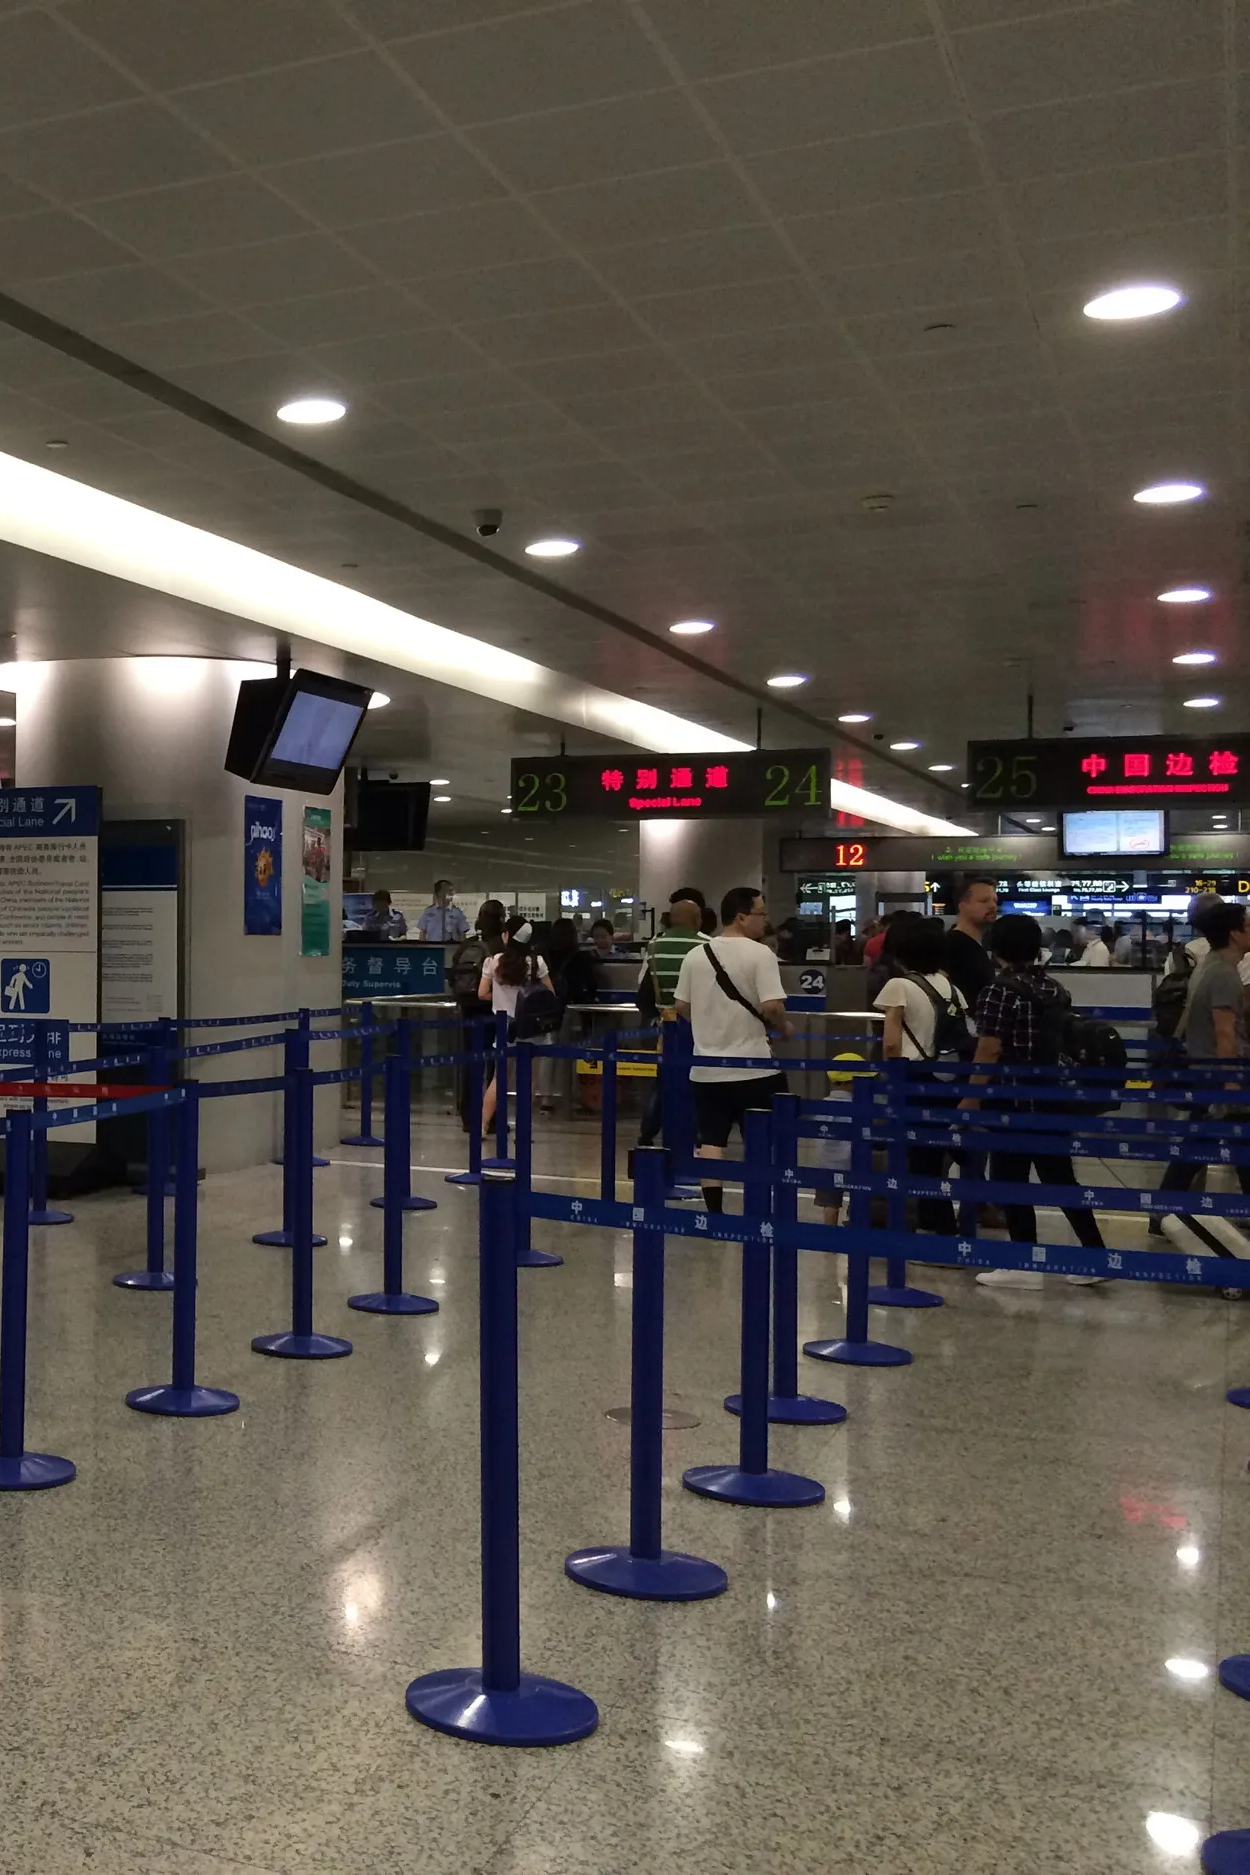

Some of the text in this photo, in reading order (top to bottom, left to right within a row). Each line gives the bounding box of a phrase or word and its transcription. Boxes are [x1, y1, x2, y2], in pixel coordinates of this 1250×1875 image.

[976, 755, 1038, 799] 25
[1081, 750, 1238, 778] 中国边检
[601, 765, 729, 791] 特别通道
[764, 764, 822, 806] 24
[517, 773, 568, 812] 23
[18, 817, 44, 827] Lane
[835, 844, 865, 866] 12
[801, 975, 825, 989] 24
